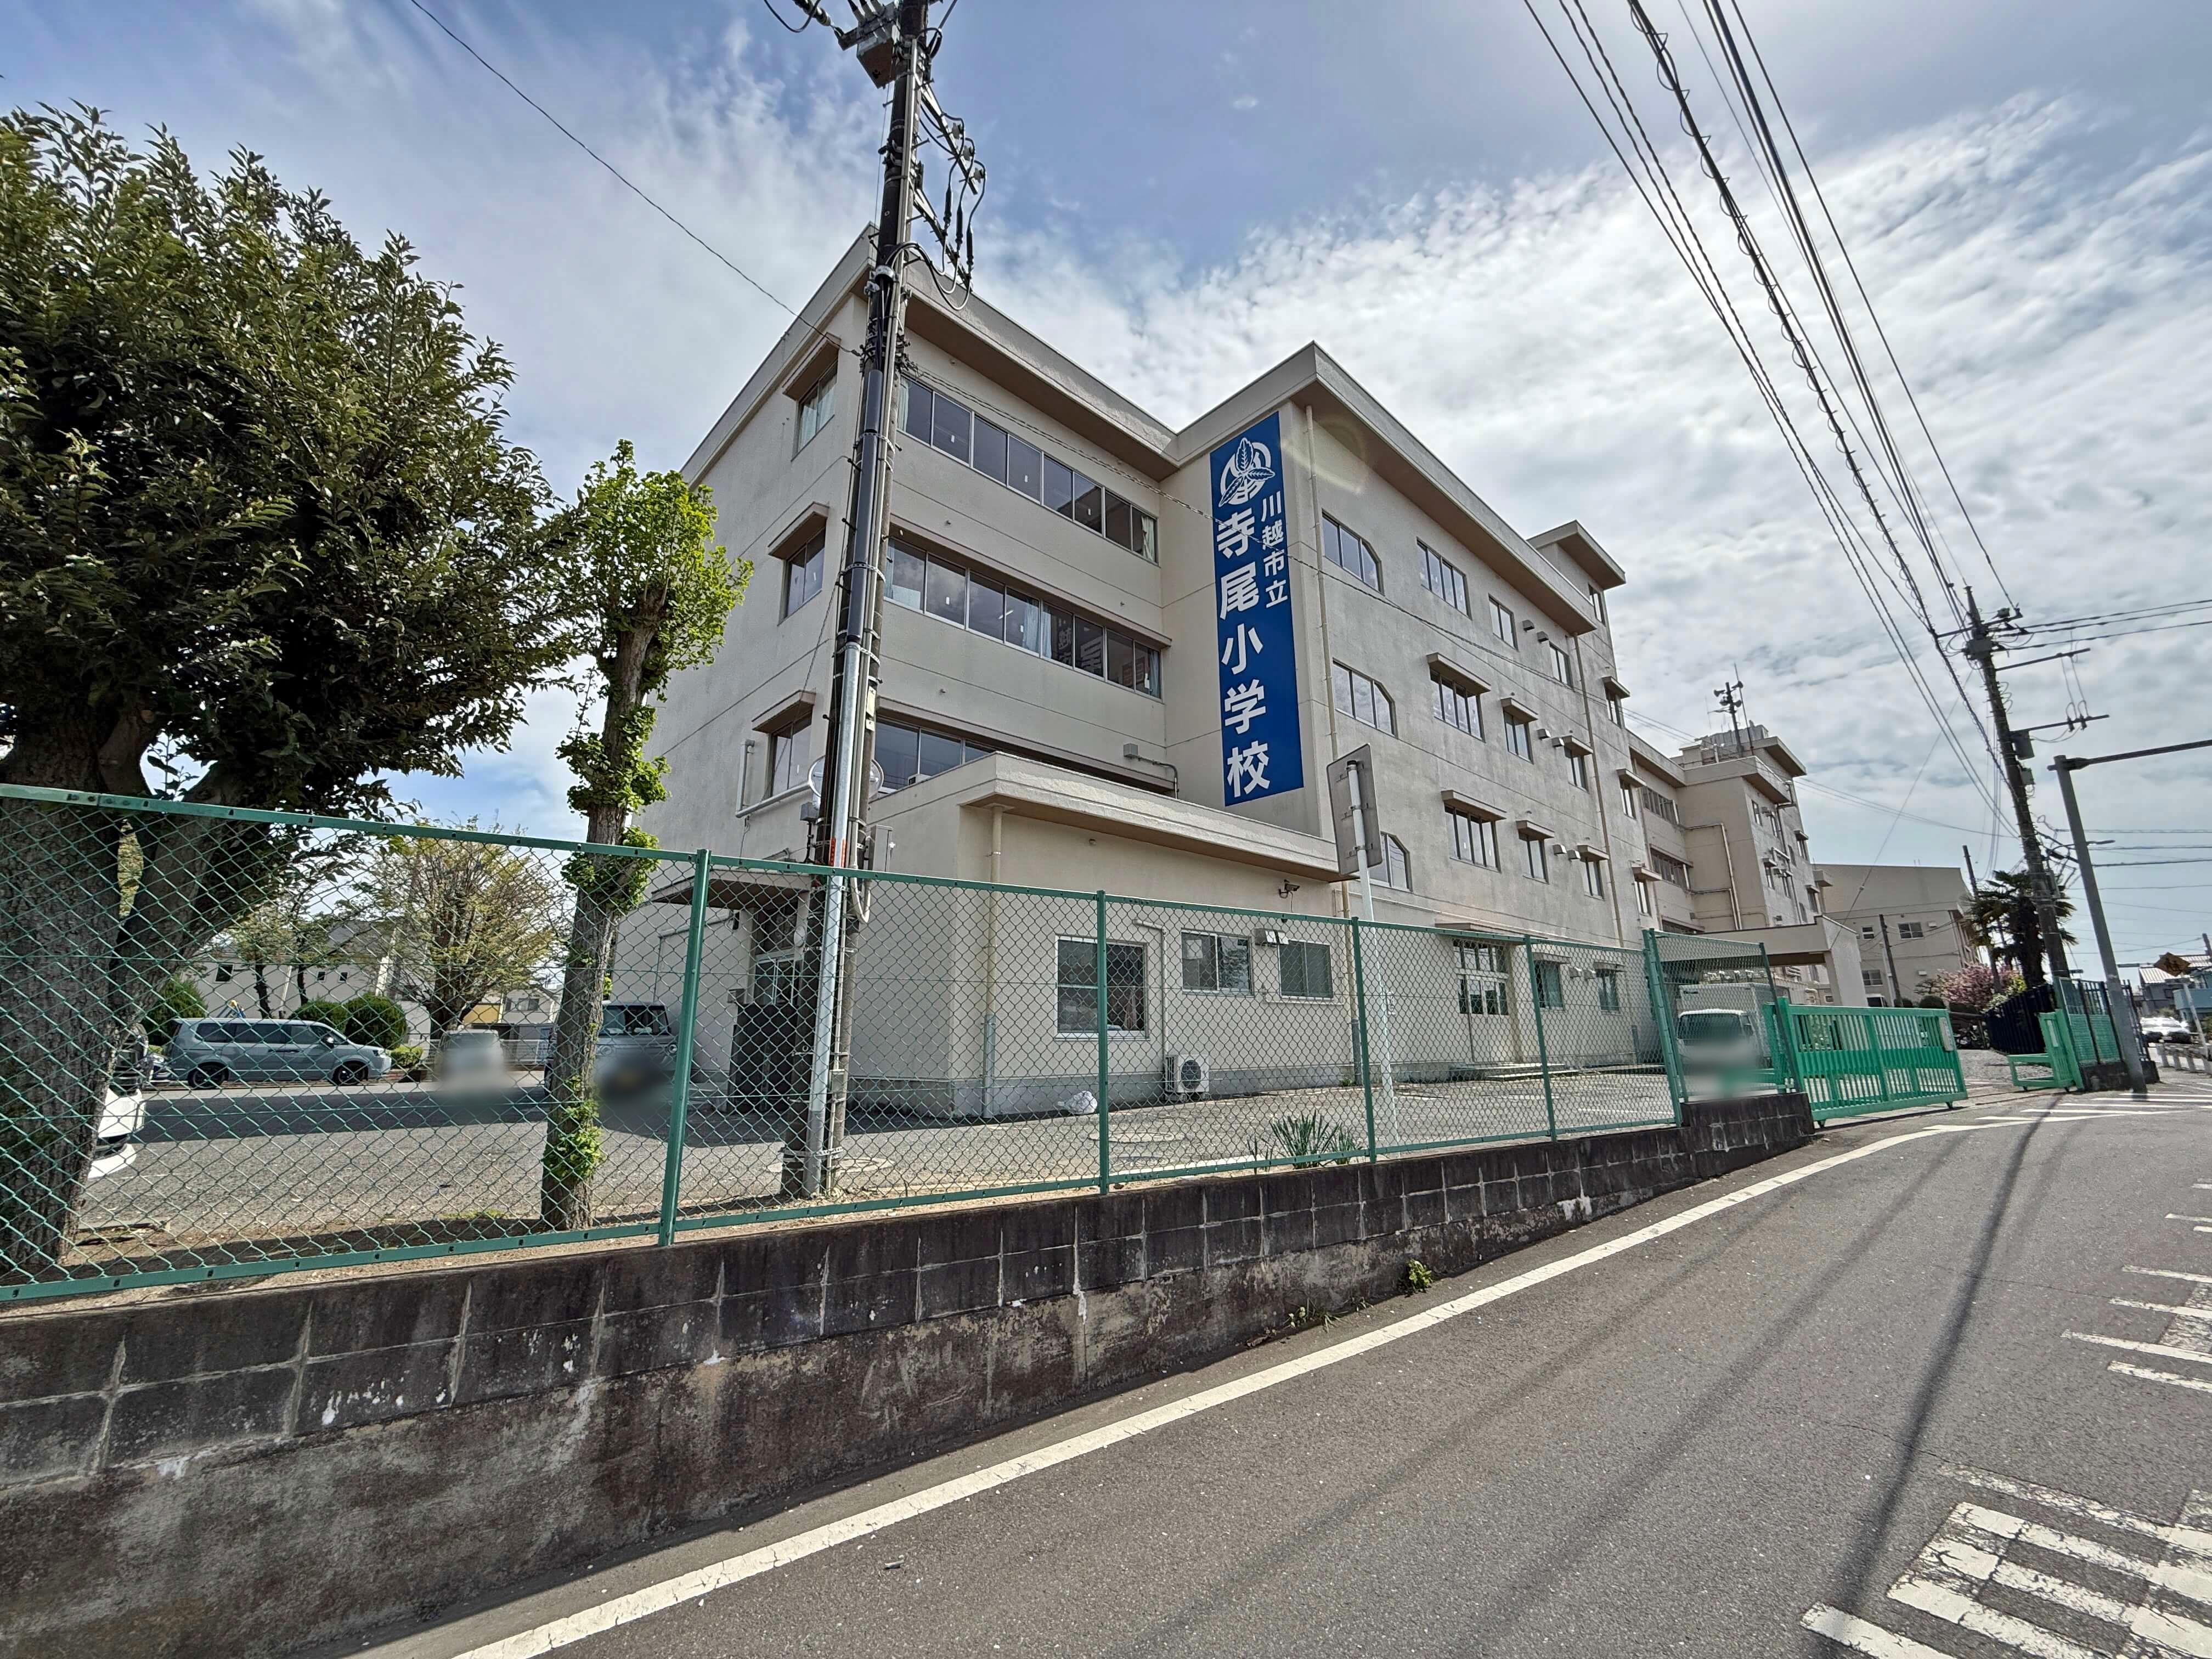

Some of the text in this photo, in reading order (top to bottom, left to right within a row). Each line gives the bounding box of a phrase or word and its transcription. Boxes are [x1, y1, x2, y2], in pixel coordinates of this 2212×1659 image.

[1261, 490, 1288, 608] 川越市立
[1216, 507, 1271, 797] 寺尾小学校
